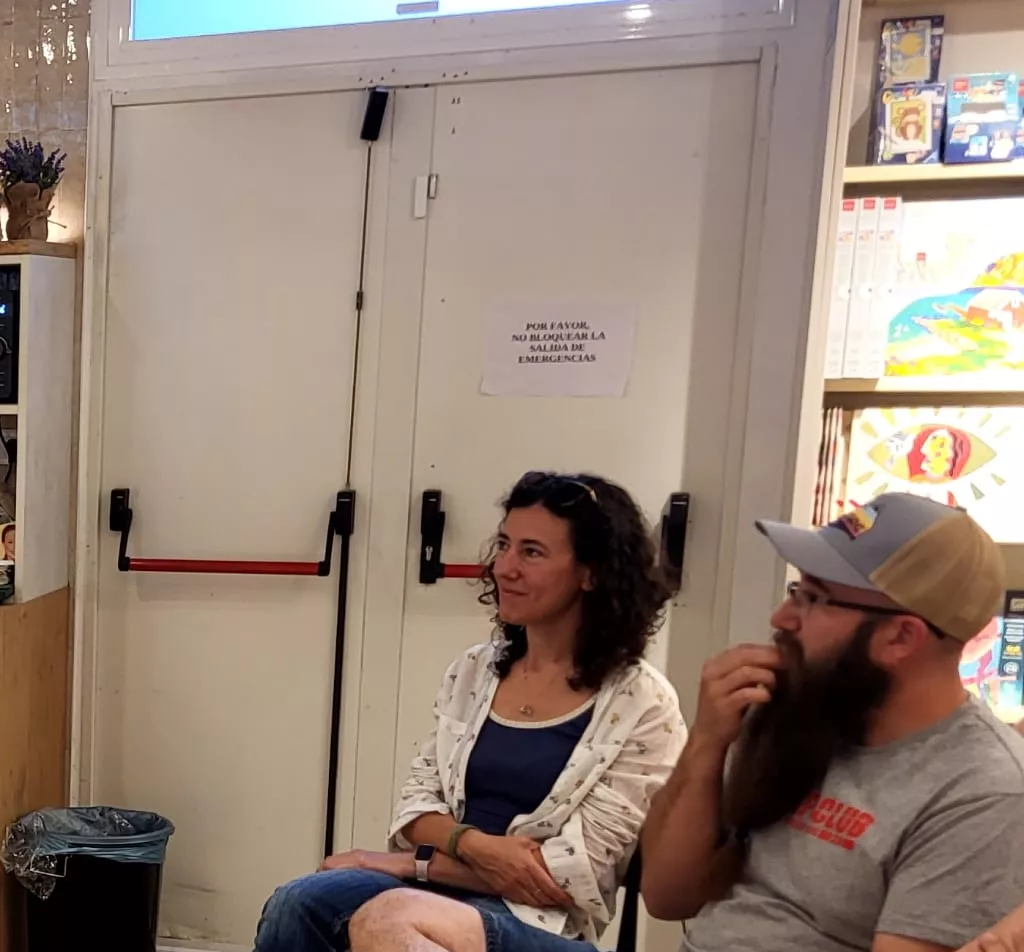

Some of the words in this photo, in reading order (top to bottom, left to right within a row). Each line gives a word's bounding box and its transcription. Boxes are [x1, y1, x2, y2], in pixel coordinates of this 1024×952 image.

[525, 321, 548, 331] POR
[529, 332, 588, 342] BLOQUEAR
[590, 331, 606, 341] LA
[529, 343, 569, 352] SALIDA
[570, 343, 585, 352] DE
[518, 354, 597, 363] EMERGENCIAS
